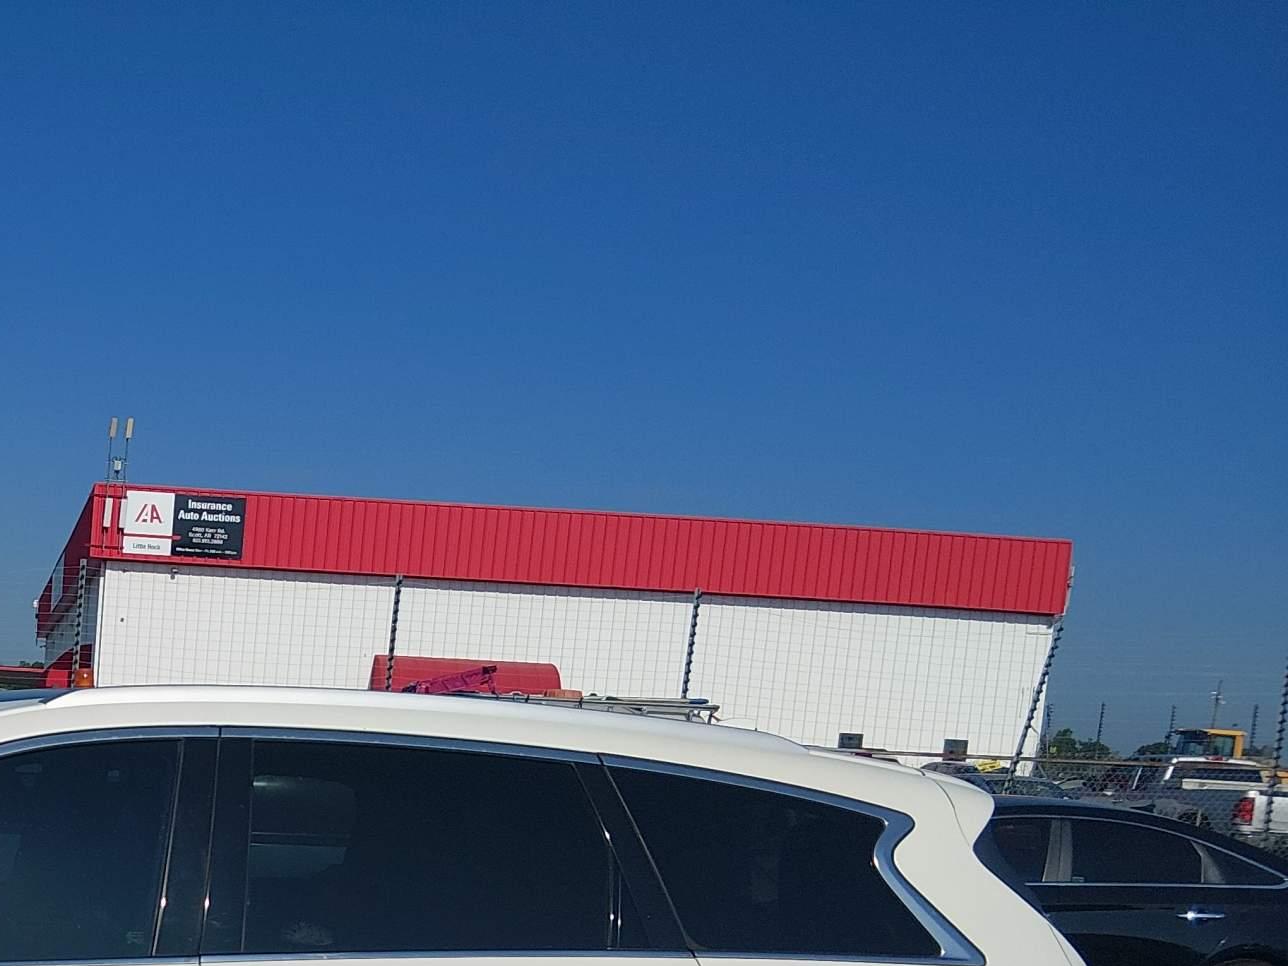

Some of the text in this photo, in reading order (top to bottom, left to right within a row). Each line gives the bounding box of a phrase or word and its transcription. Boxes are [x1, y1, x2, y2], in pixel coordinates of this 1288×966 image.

[188, 499, 233, 511] Insurance
[178, 510, 241, 523] Auto Auctions
